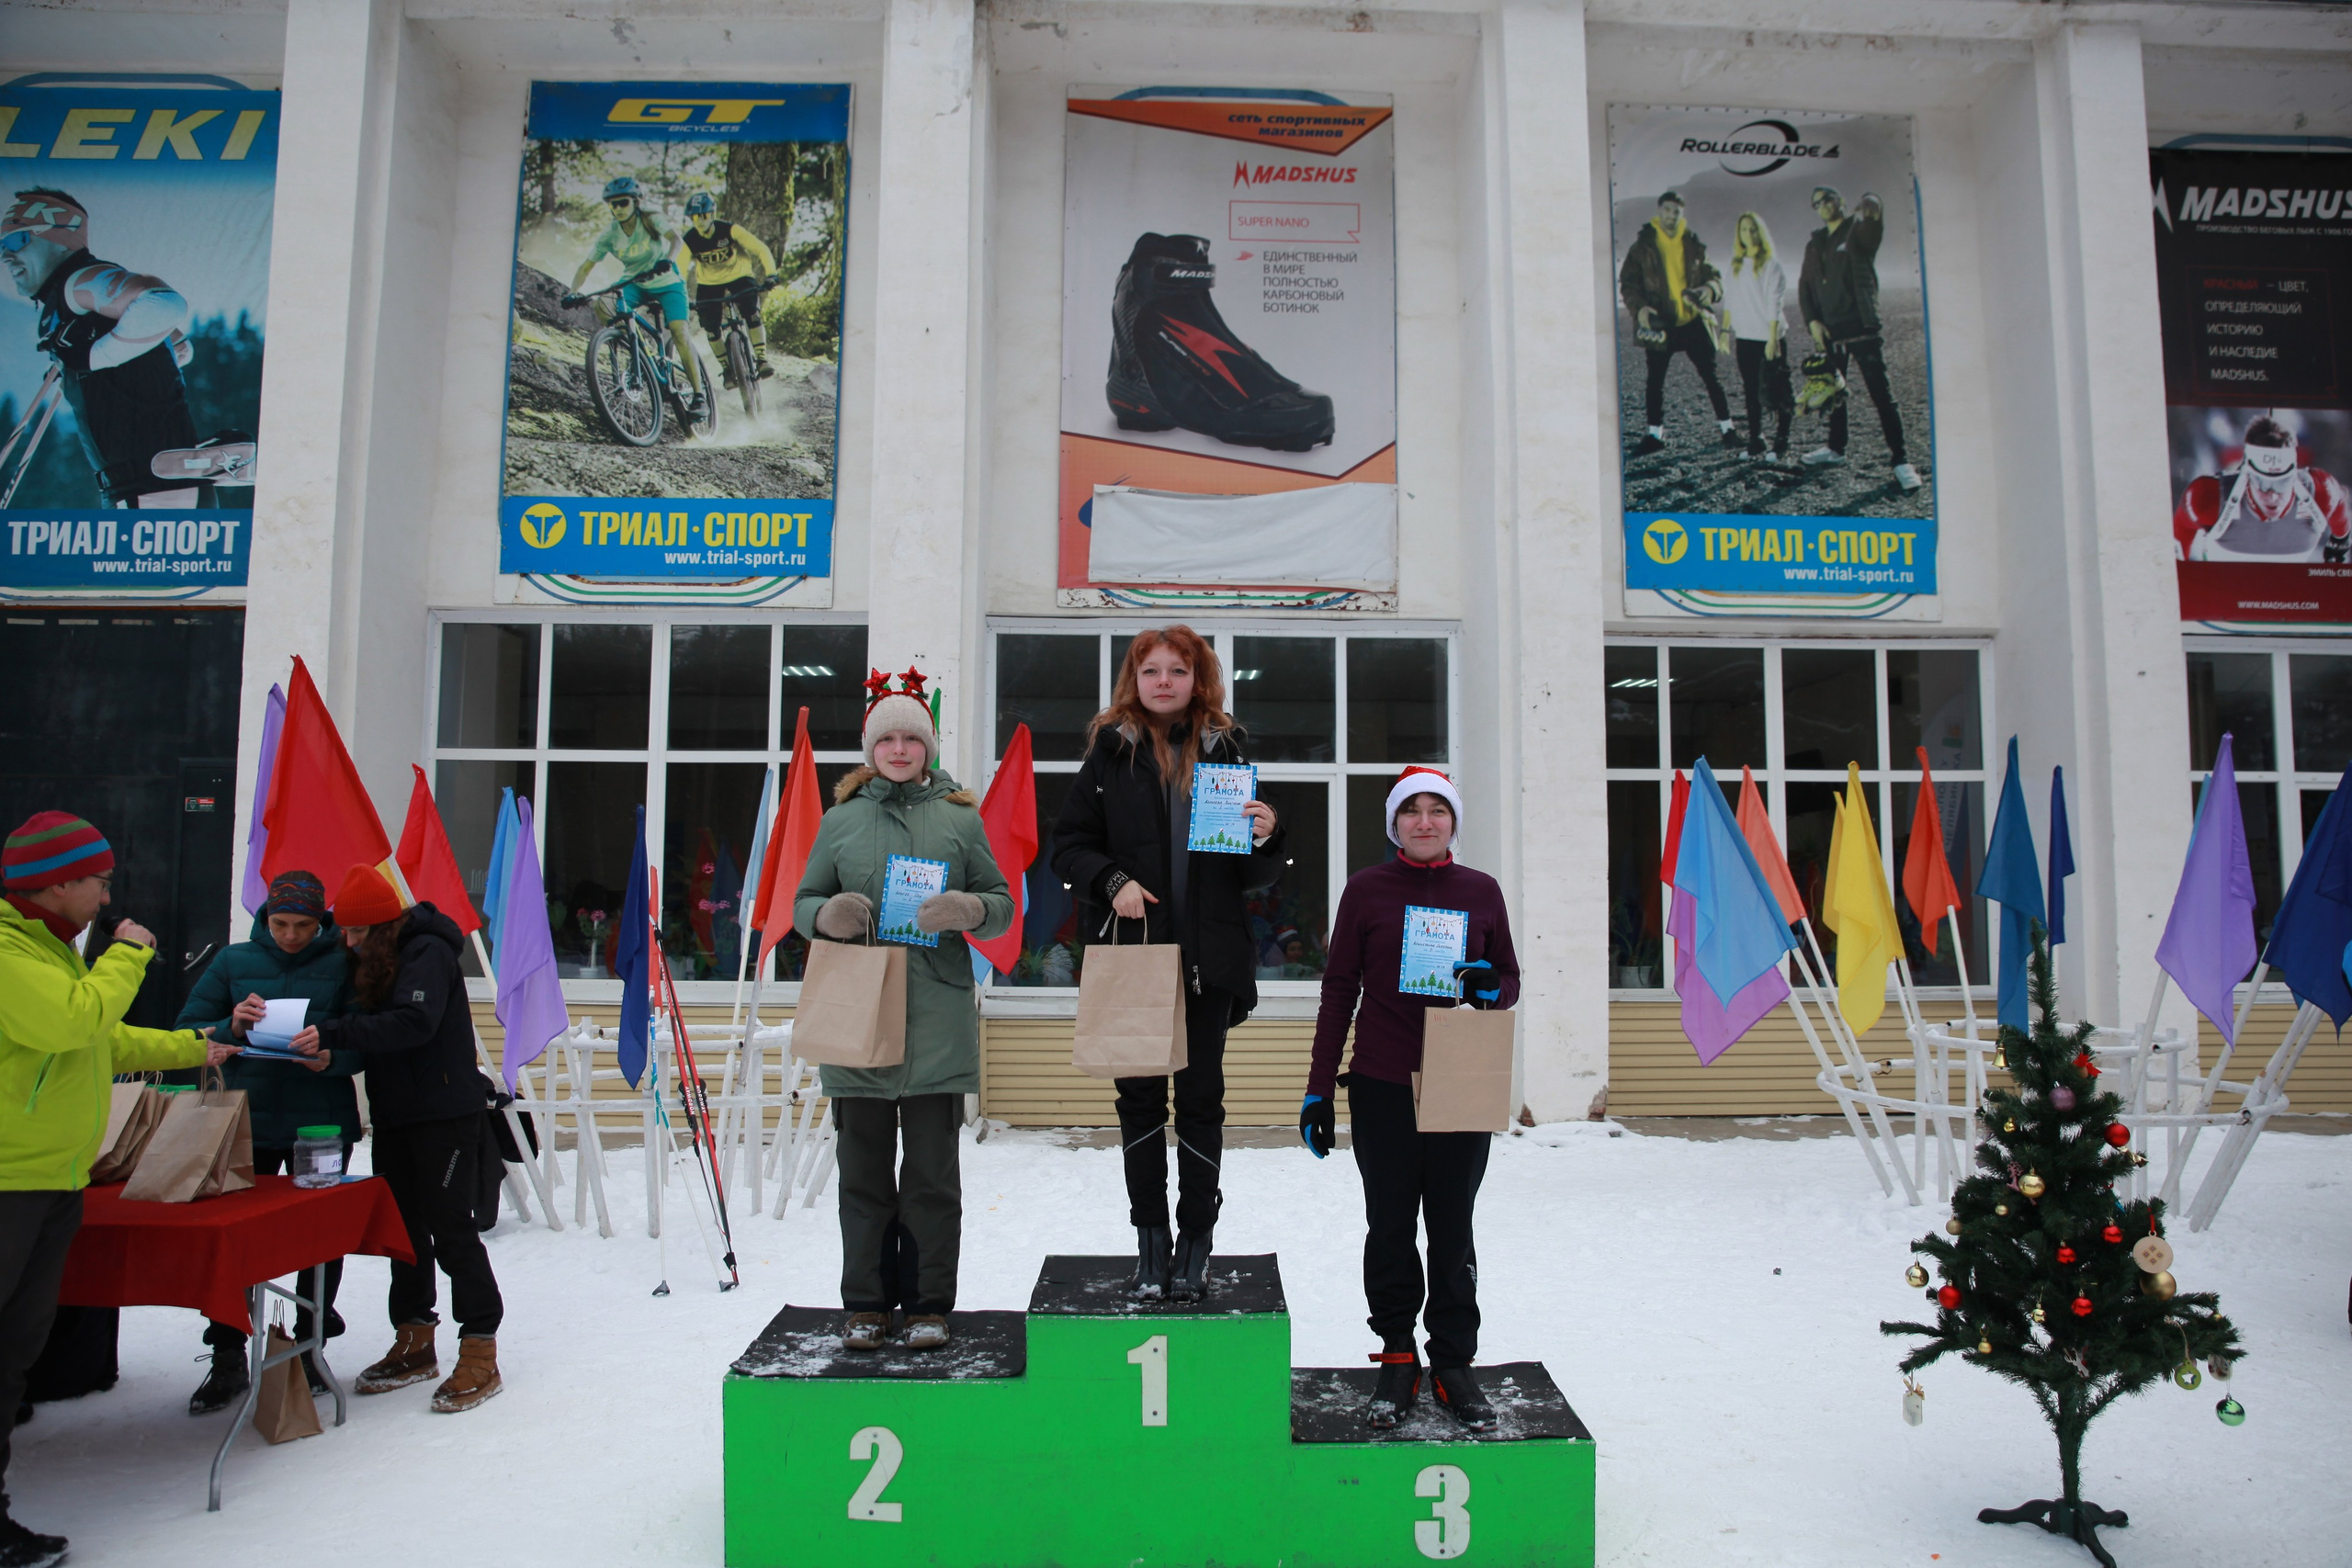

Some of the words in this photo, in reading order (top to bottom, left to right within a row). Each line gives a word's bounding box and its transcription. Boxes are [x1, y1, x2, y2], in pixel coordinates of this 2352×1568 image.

[606, 98, 786, 123] GT
[1228, 114, 1262, 123] сеть
[1267, 115, 1366, 127] спортивных
[0, 106, 266, 161] LEKI
[1259, 127, 1344, 138] магазинов
[1679, 139, 1822, 159] ROLLERBLADE
[1251, 165, 1358, 184] MADSHUS
[1238, 216, 1273, 228] SUPER
[1275, 217, 1310, 229] NANO
[1262, 251, 1358, 264] ЕДИНСТВЕННЫЙ
[1262, 264, 1270, 275] В
[1272, 264, 1306, 276] МИРЕ
[1262, 276, 1339, 288] ПОЛНОСТЬЮ
[2203, 278, 2258, 289] КРАСНЫЙ
[2278, 280, 2310, 293] ЦВЕТ,
[1262, 289, 1344, 302] КАРБОНОВЫЙ
[1262, 302, 1320, 314] БОТИНОК
[2205, 300, 2302, 314] ОПРЕДЕЛЯЮЩИЙ
[2207, 323, 2264, 335] ИСТОРИЮ
[2209, 345, 2218, 356] И
[2220, 346, 2278, 358] НАСЛЕДИЕ
[93, 558, 232, 576] www.trial-sport.ru
[664, 551, 807, 569] www.trial-sport.ru
[1783, 567, 1915, 584] www.trial-sport.ru
[695, 1085, 707, 1113] NORDWAY
[442, 1148, 460, 1188] noname
[1126, 1335, 1168, 1427] 1
[847, 1426, 904, 1522] 2
[1414, 1464, 1471, 1560] 3
